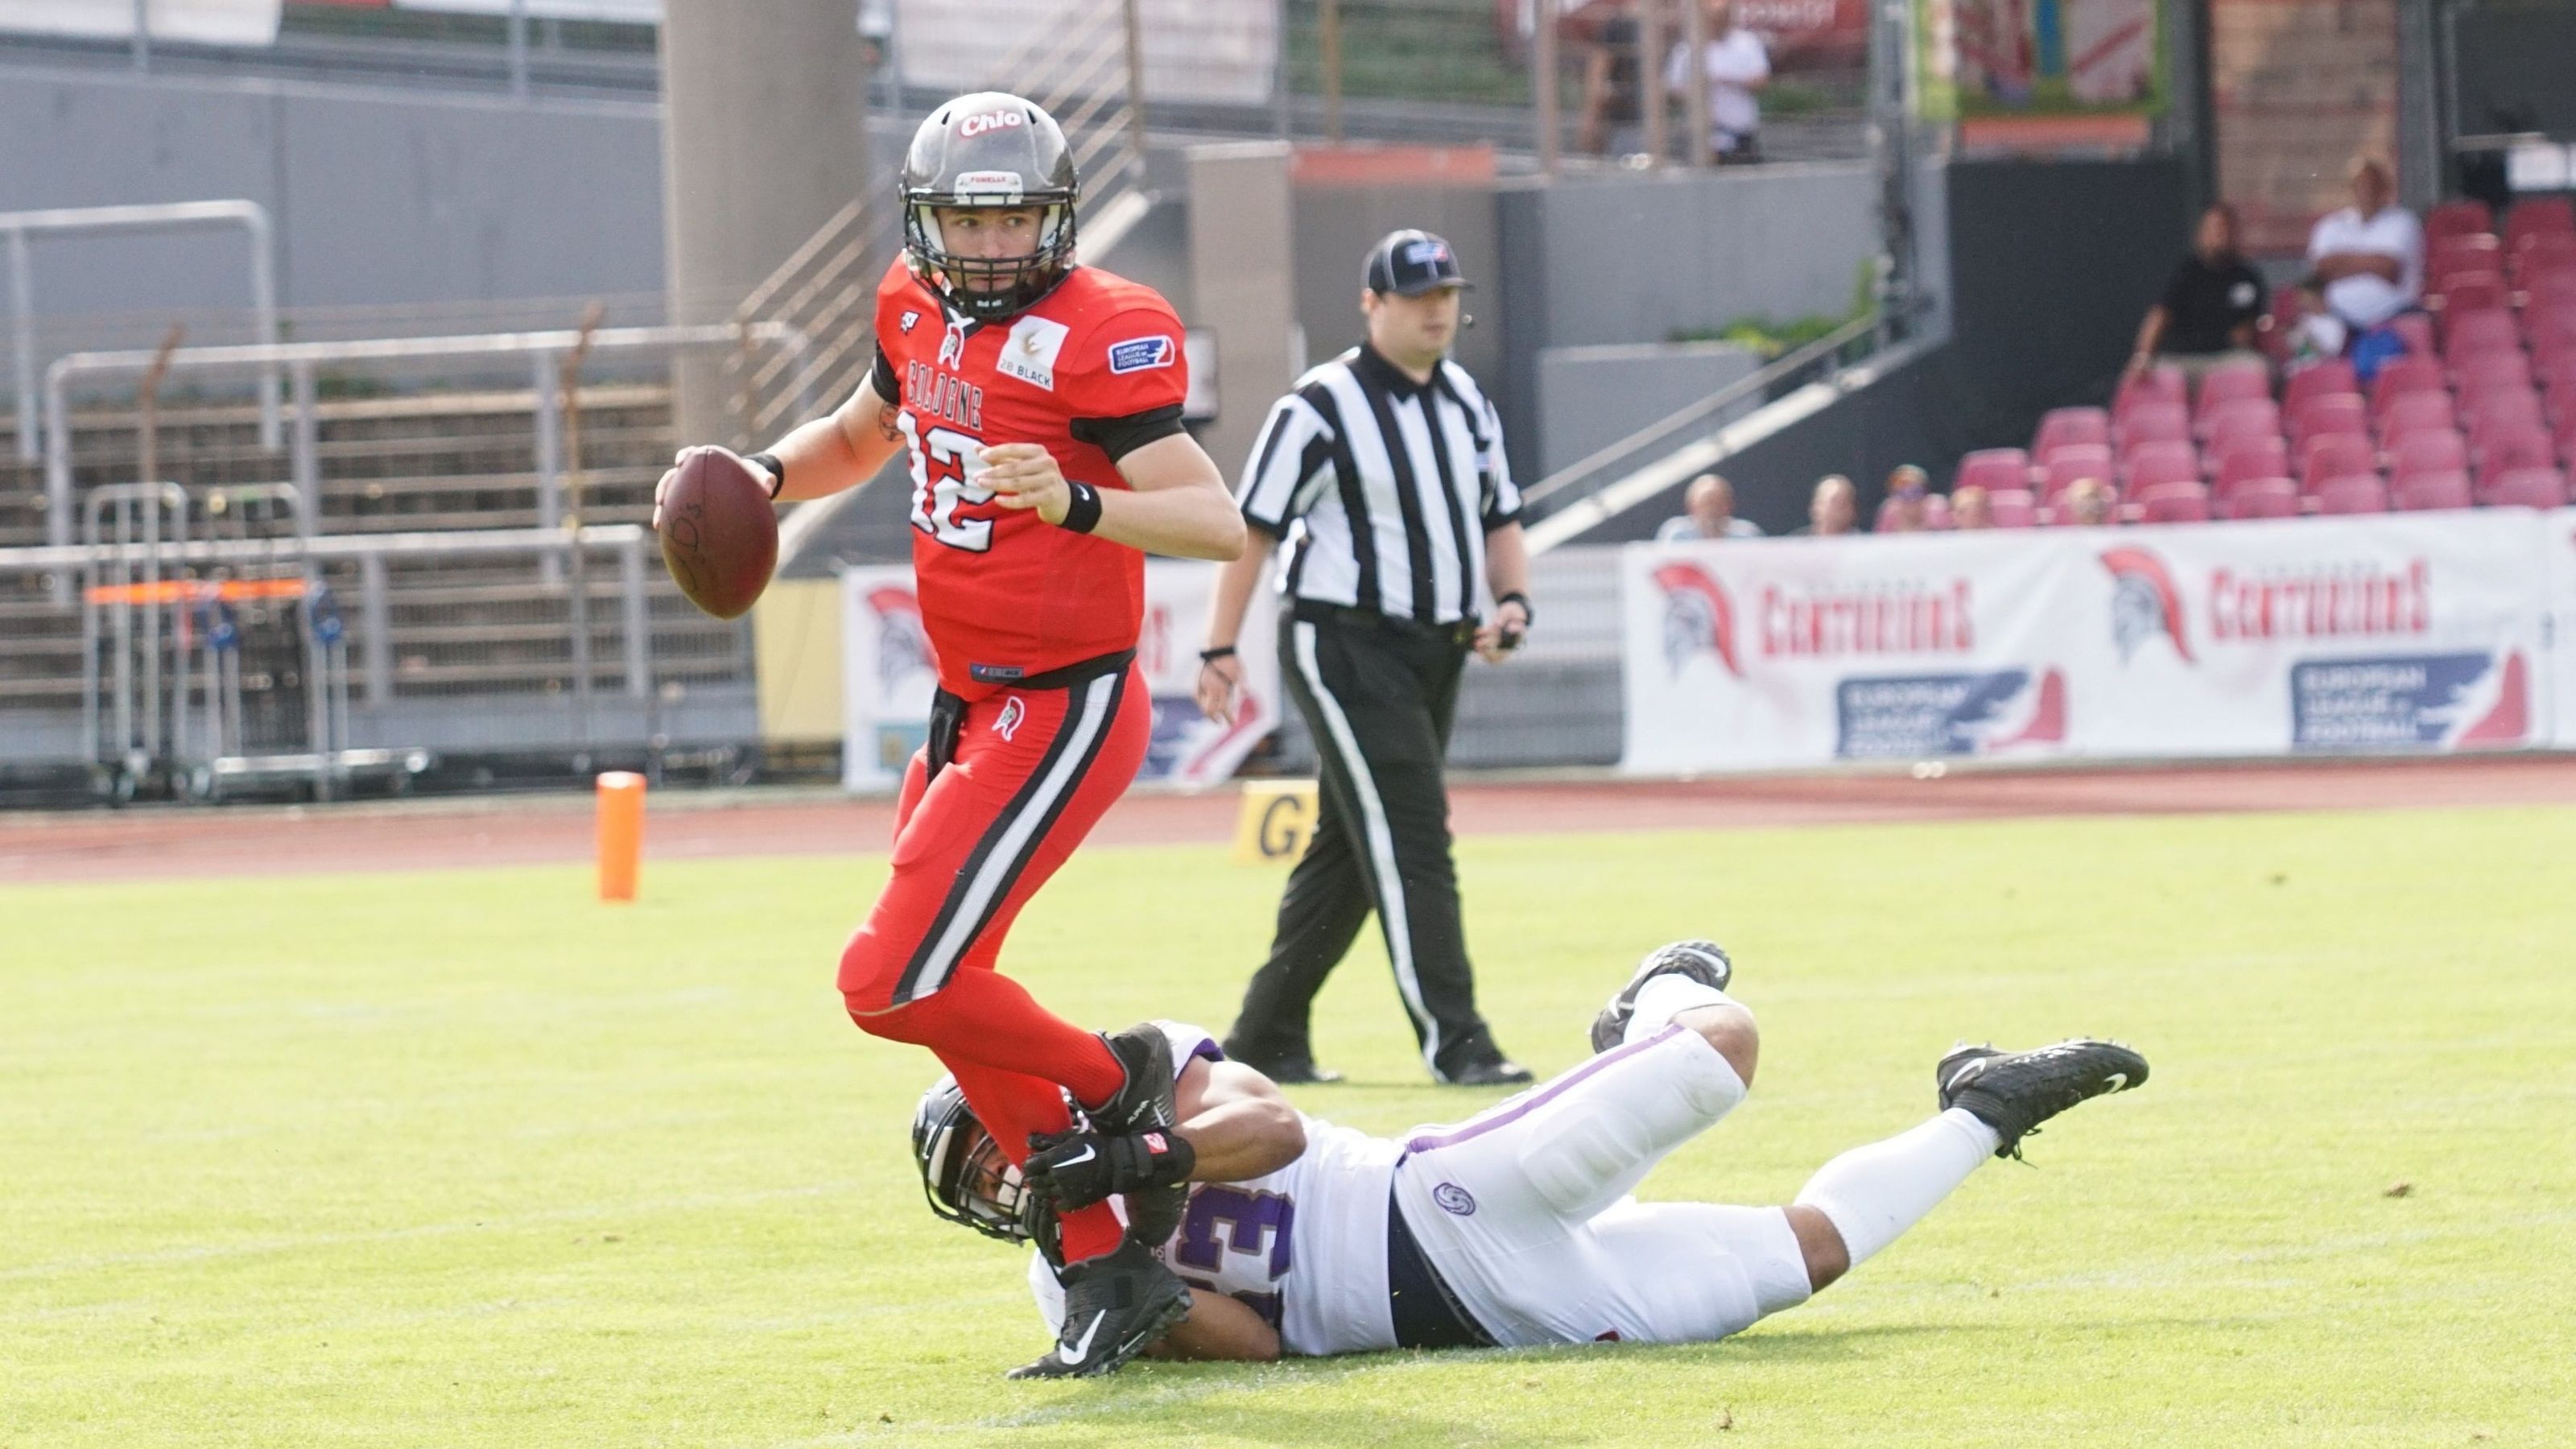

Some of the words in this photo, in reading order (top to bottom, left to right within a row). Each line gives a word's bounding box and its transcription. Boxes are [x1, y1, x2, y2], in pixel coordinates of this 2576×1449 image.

[960, 109, 1022, 137] Chio
[1116, 343, 1149, 356] EUROPEAN
[907, 359, 983, 431] COLOGNE
[1017, 365, 1051, 387] BLACK
[896, 410, 996, 552] 12
[1260, 794, 1302, 858] G
